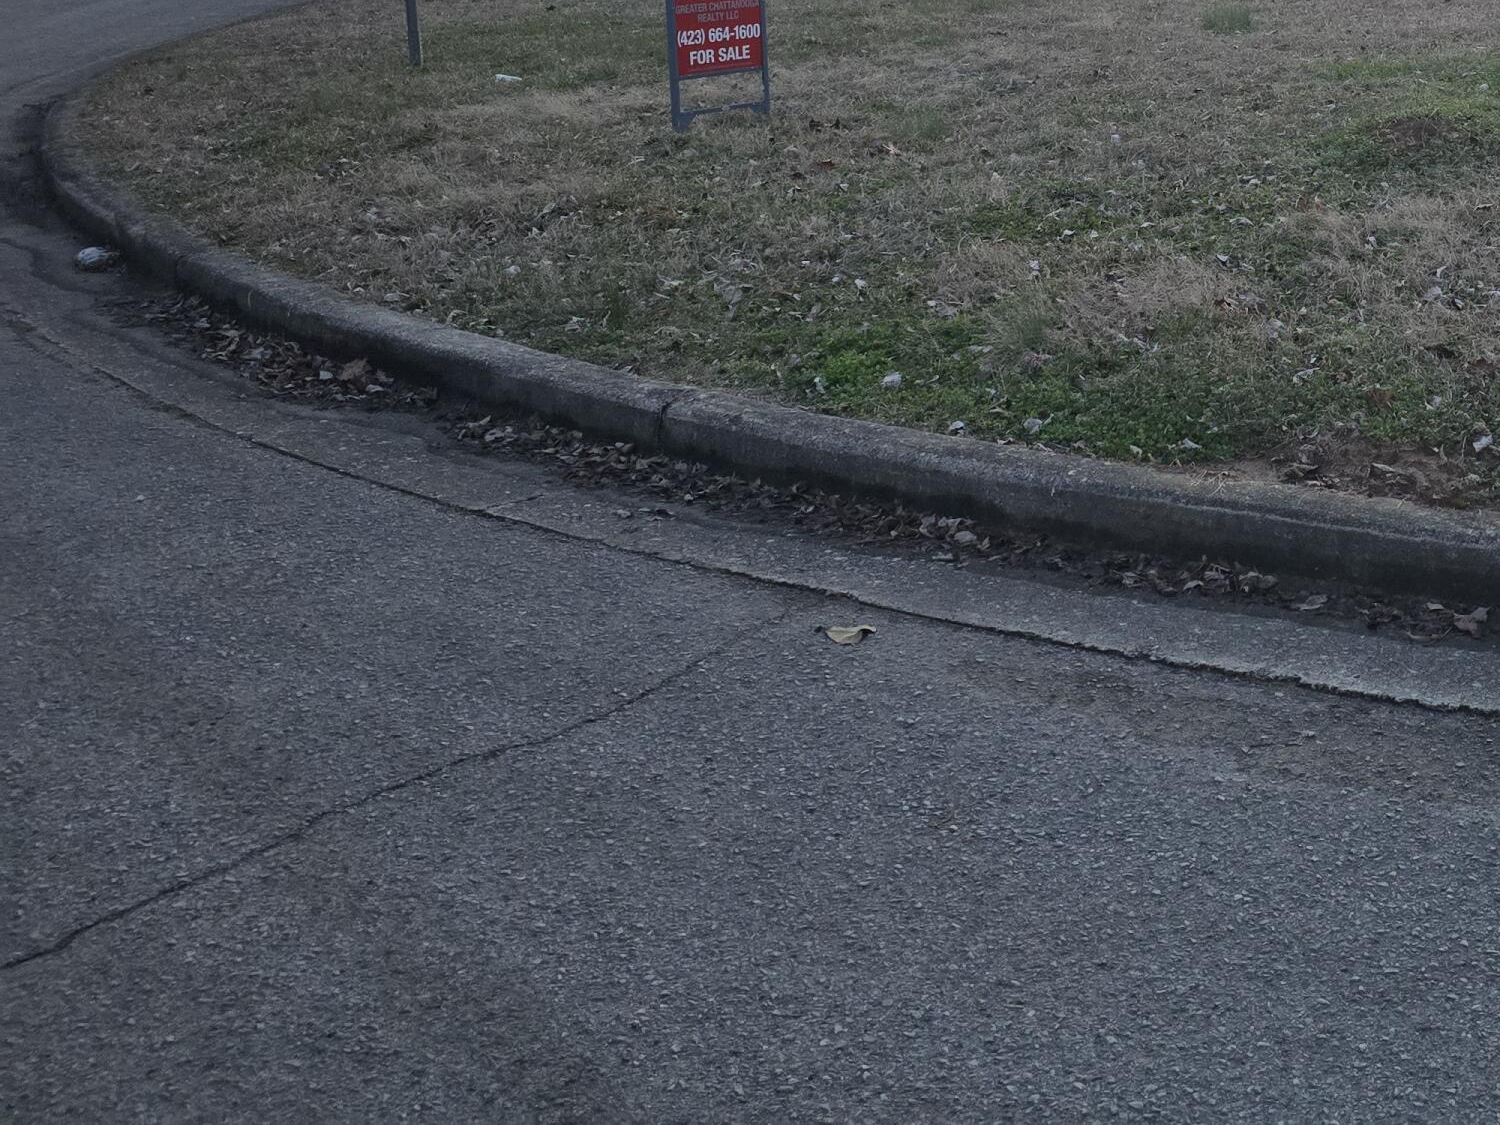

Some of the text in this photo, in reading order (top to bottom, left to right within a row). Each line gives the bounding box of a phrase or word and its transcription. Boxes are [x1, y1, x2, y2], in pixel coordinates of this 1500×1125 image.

[675, 2, 707, 15] GREATER
[697, 10, 740, 23] REALTY LLC
[677, 23, 761, 48] (423) 664-1600
[689, 45, 751, 66] FOR SALE
